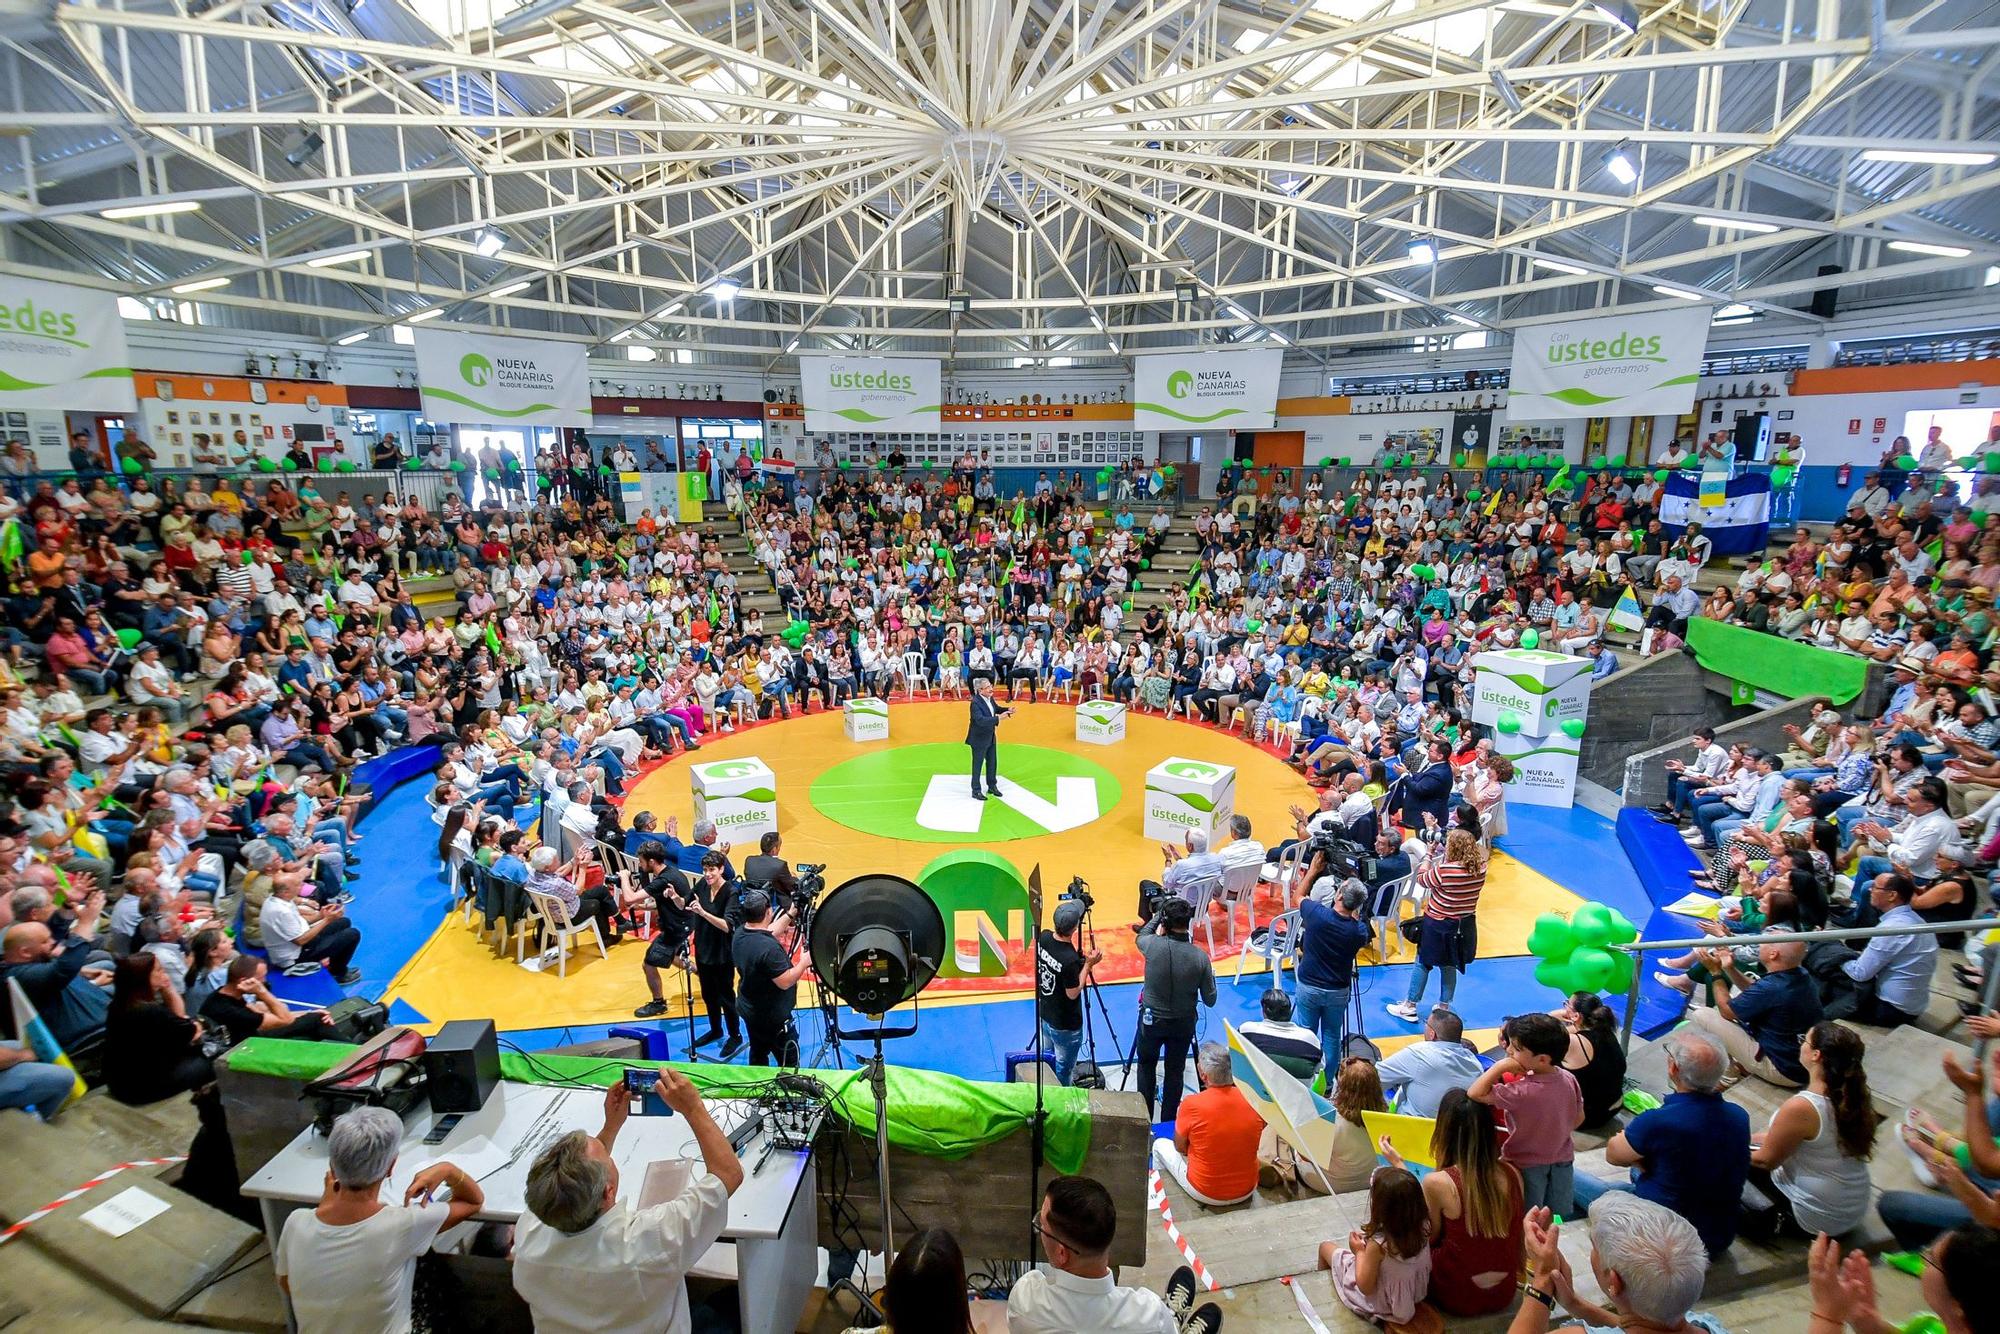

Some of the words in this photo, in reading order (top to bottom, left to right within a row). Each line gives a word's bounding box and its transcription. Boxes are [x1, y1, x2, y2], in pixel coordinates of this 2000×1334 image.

[1551, 332, 1569, 342] Con
[1548, 332, 1661, 362] ustedes
[497, 358, 537, 370] NUEVA
[831, 363, 845, 372] Con
[498, 370, 554, 383] CANARIAS
[1198, 371, 1232, 380] NUEVA
[1584, 364, 1650, 379] gobernamos
[830, 370, 912, 389] ustedes
[1197, 380, 1246, 390] CANARIAS
[861, 394, 906, 402] gobernamos
[1481, 691, 1531, 710] ustedes
[1560, 702, 1583, 711] CANARIAS
[858, 722, 884, 730] ustedes
[1526, 769, 1554, 777] NUEVA
[1525, 776, 1566, 785] CANARIAS
[715, 810, 767, 826] ustedes
[1152, 808, 1201, 827] ustedes
